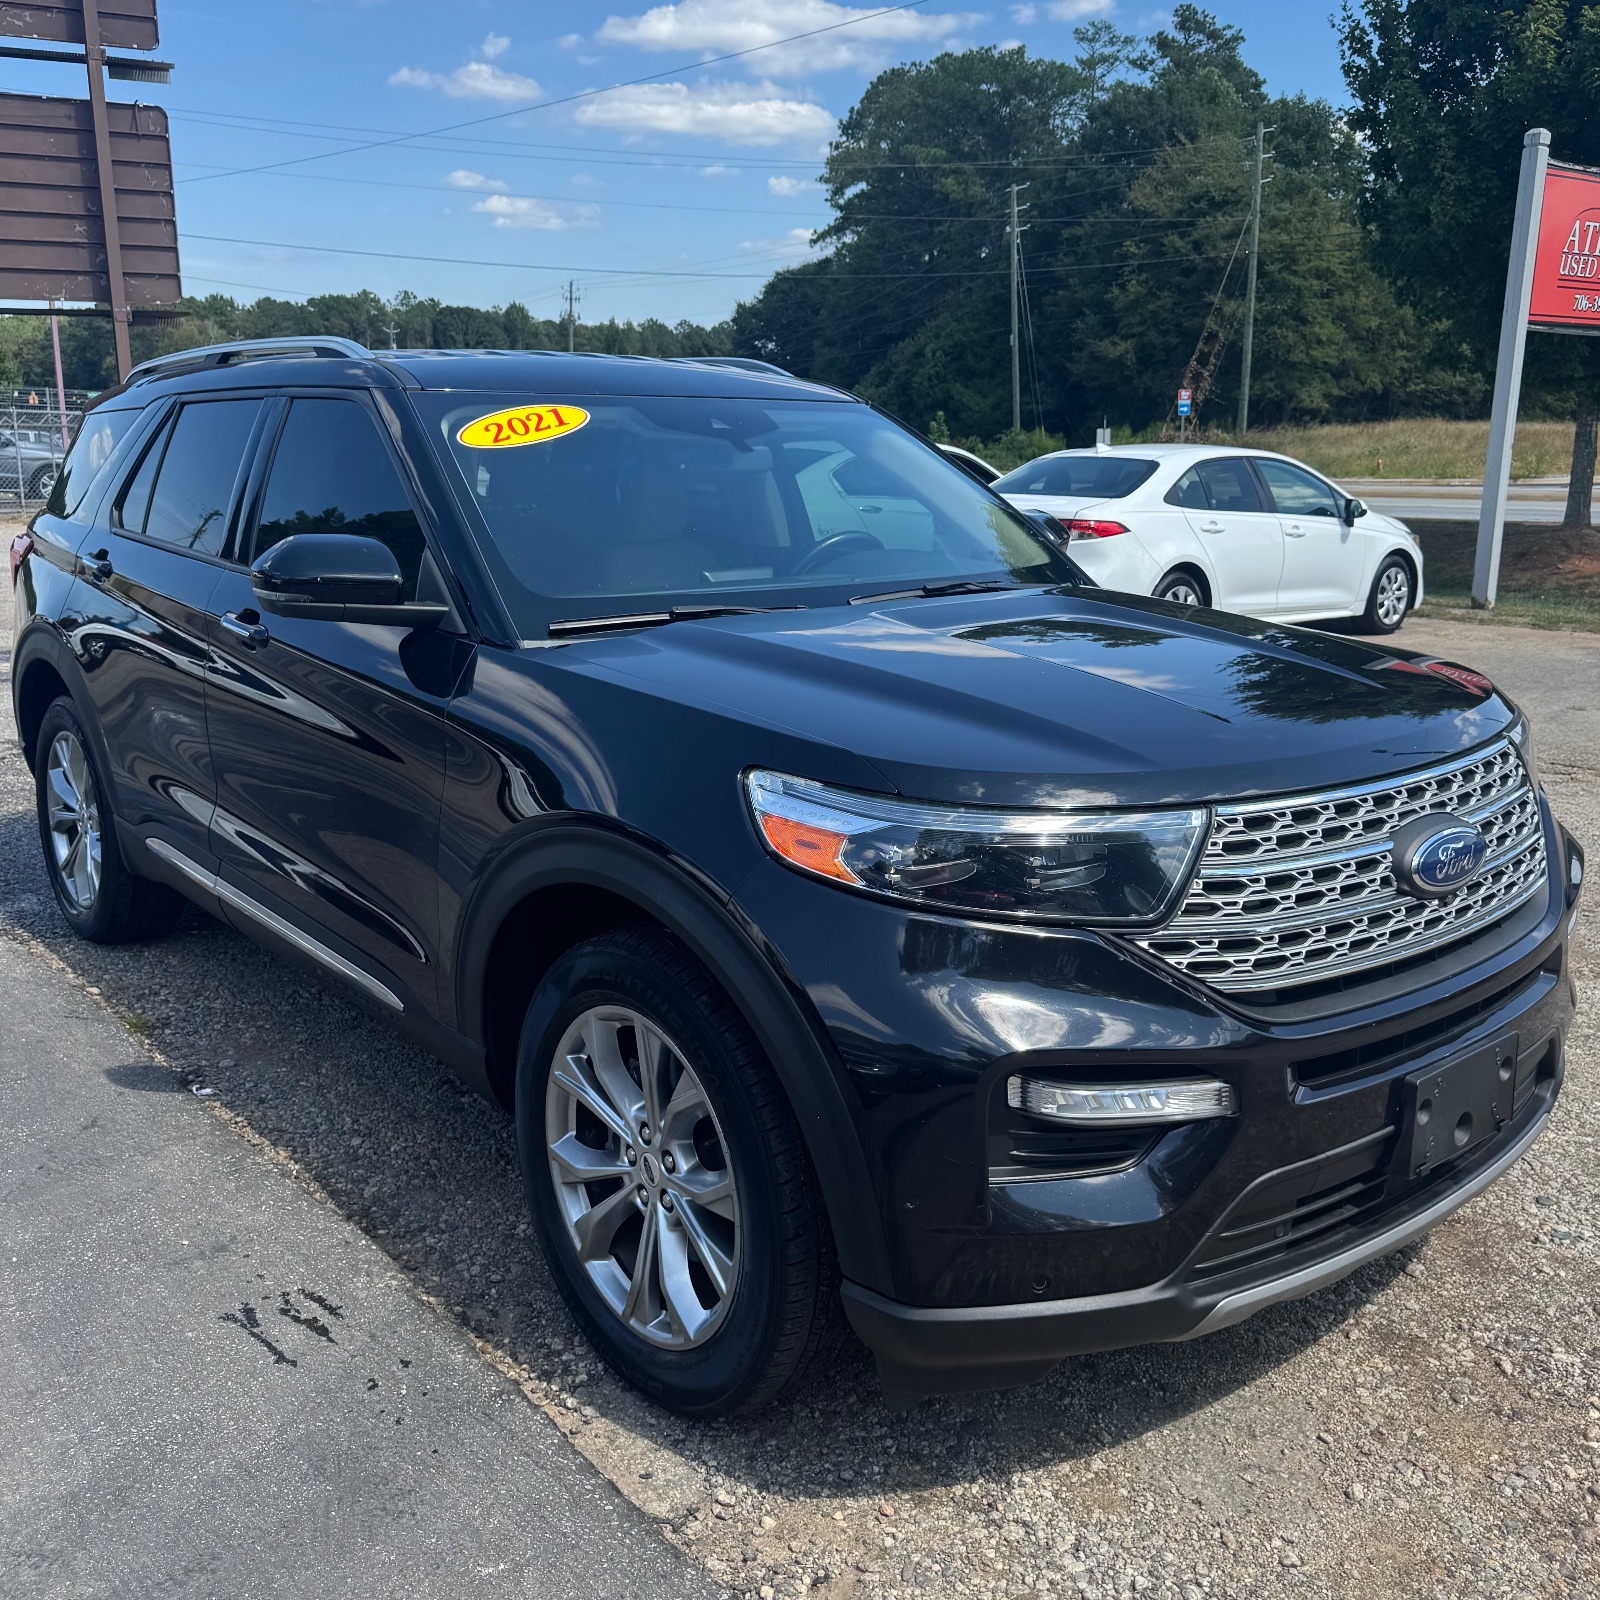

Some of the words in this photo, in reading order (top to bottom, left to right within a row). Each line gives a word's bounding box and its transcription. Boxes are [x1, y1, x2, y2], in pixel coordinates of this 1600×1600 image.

[1560, 254, 1598, 278] USED
[484, 408, 570, 443] 2021
[769, 801, 853, 827] EXPLORER
[1436, 840, 1475, 879] Ford
